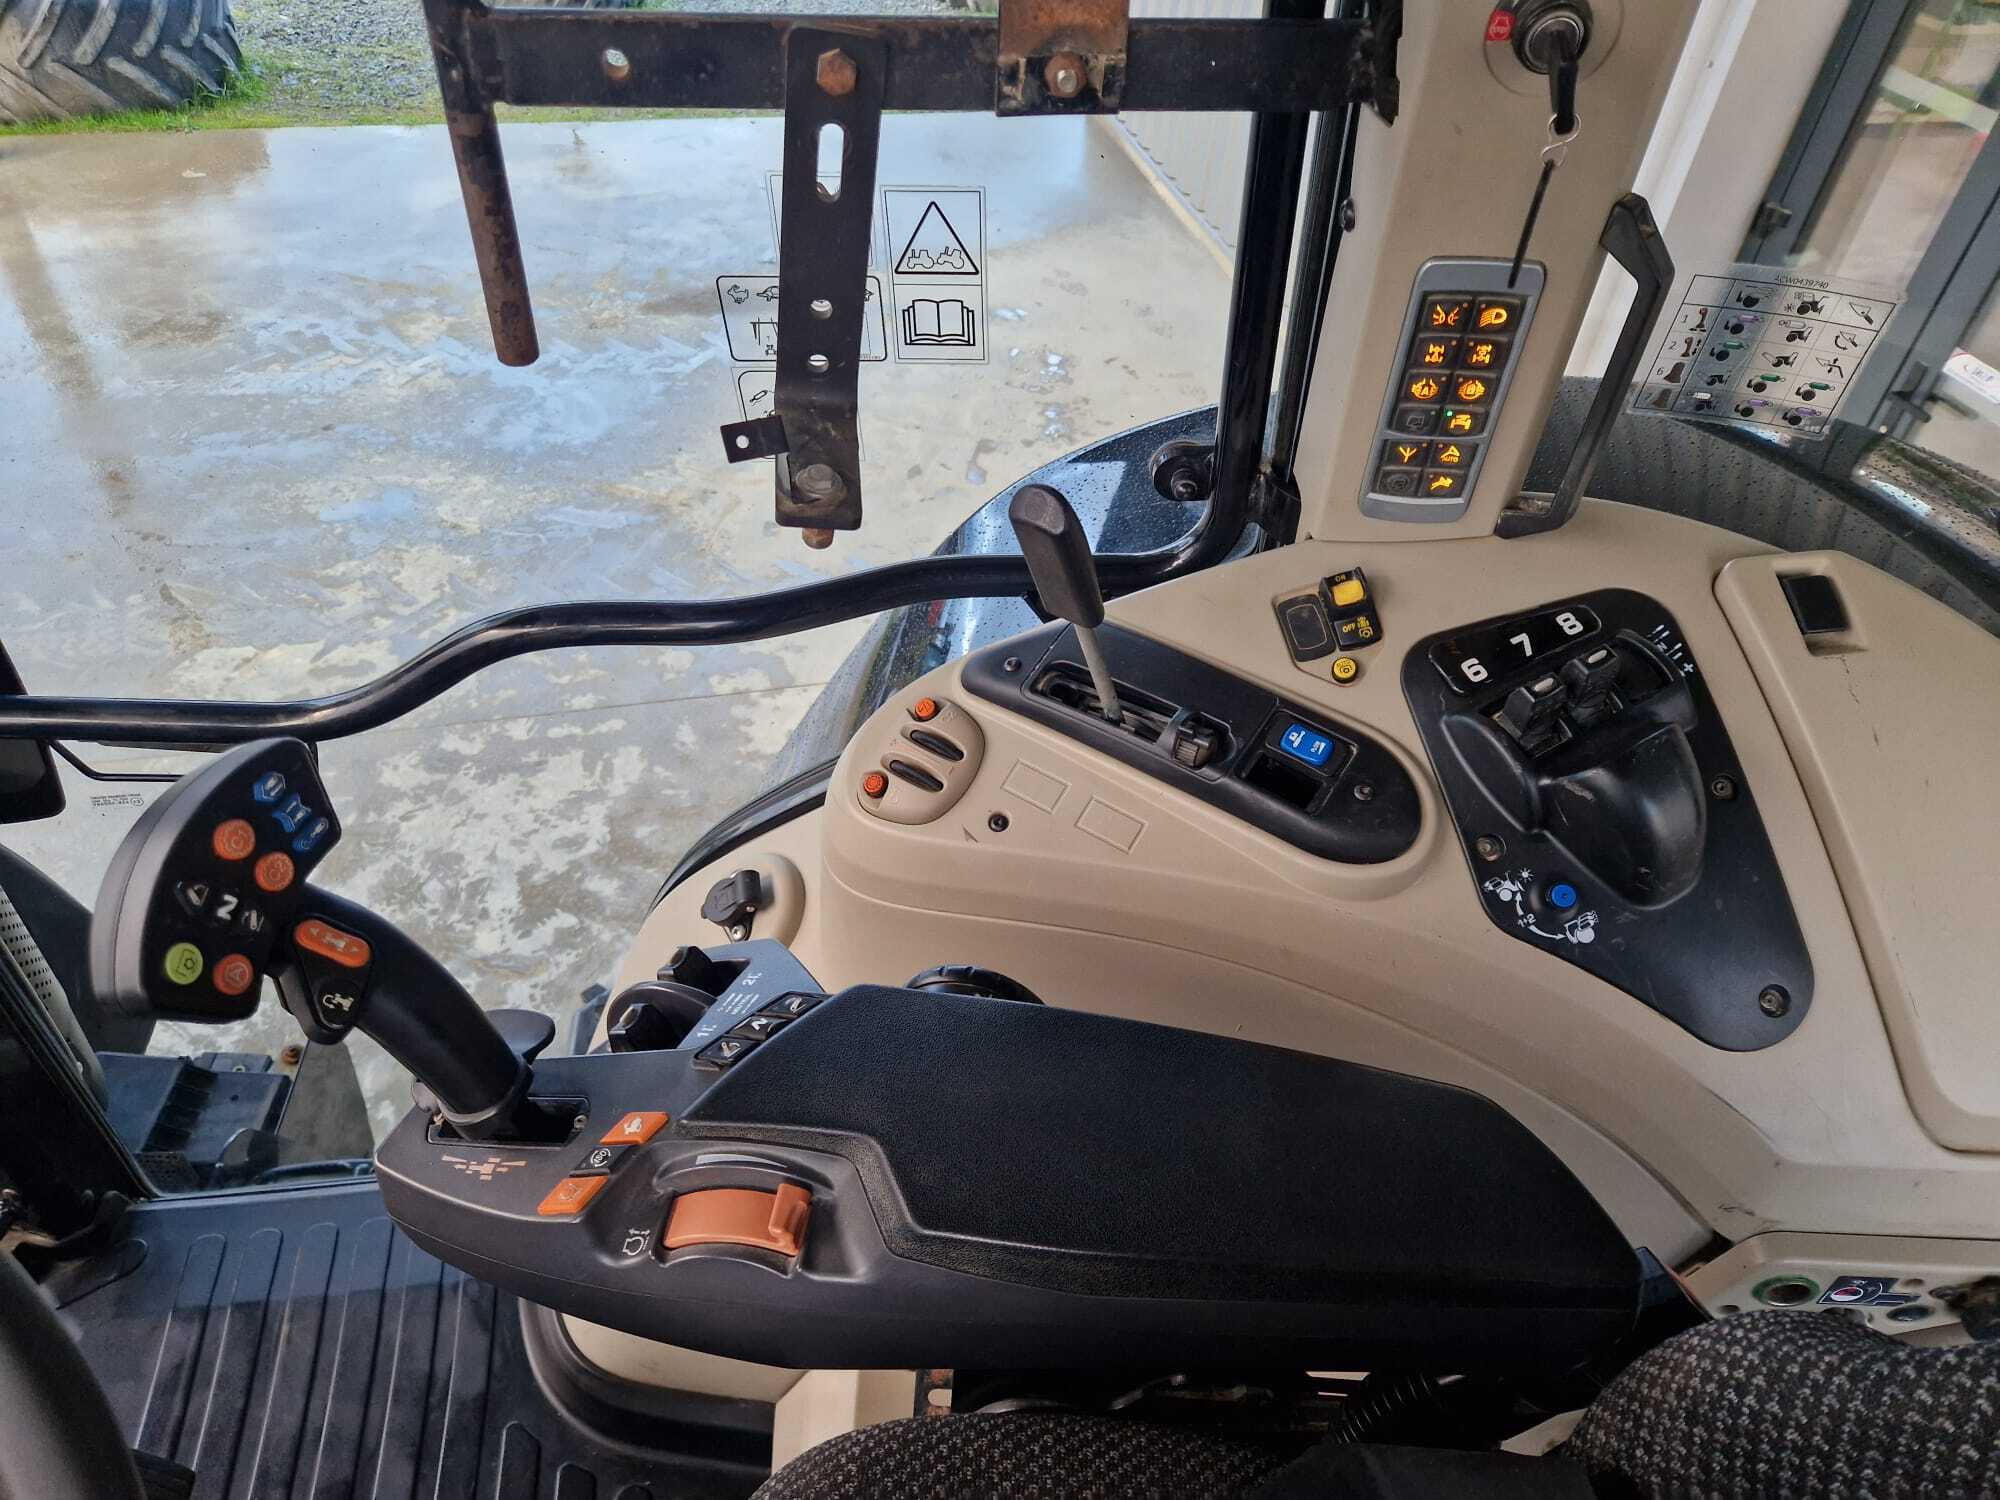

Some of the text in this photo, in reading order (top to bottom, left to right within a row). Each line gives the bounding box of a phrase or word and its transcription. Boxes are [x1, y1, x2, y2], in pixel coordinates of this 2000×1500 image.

[1342, 623, 1356, 633] OFF
[1555, 611, 1584, 636] 8
[1509, 632, 1533, 658] 7
[1460, 657, 1489, 683] 6
